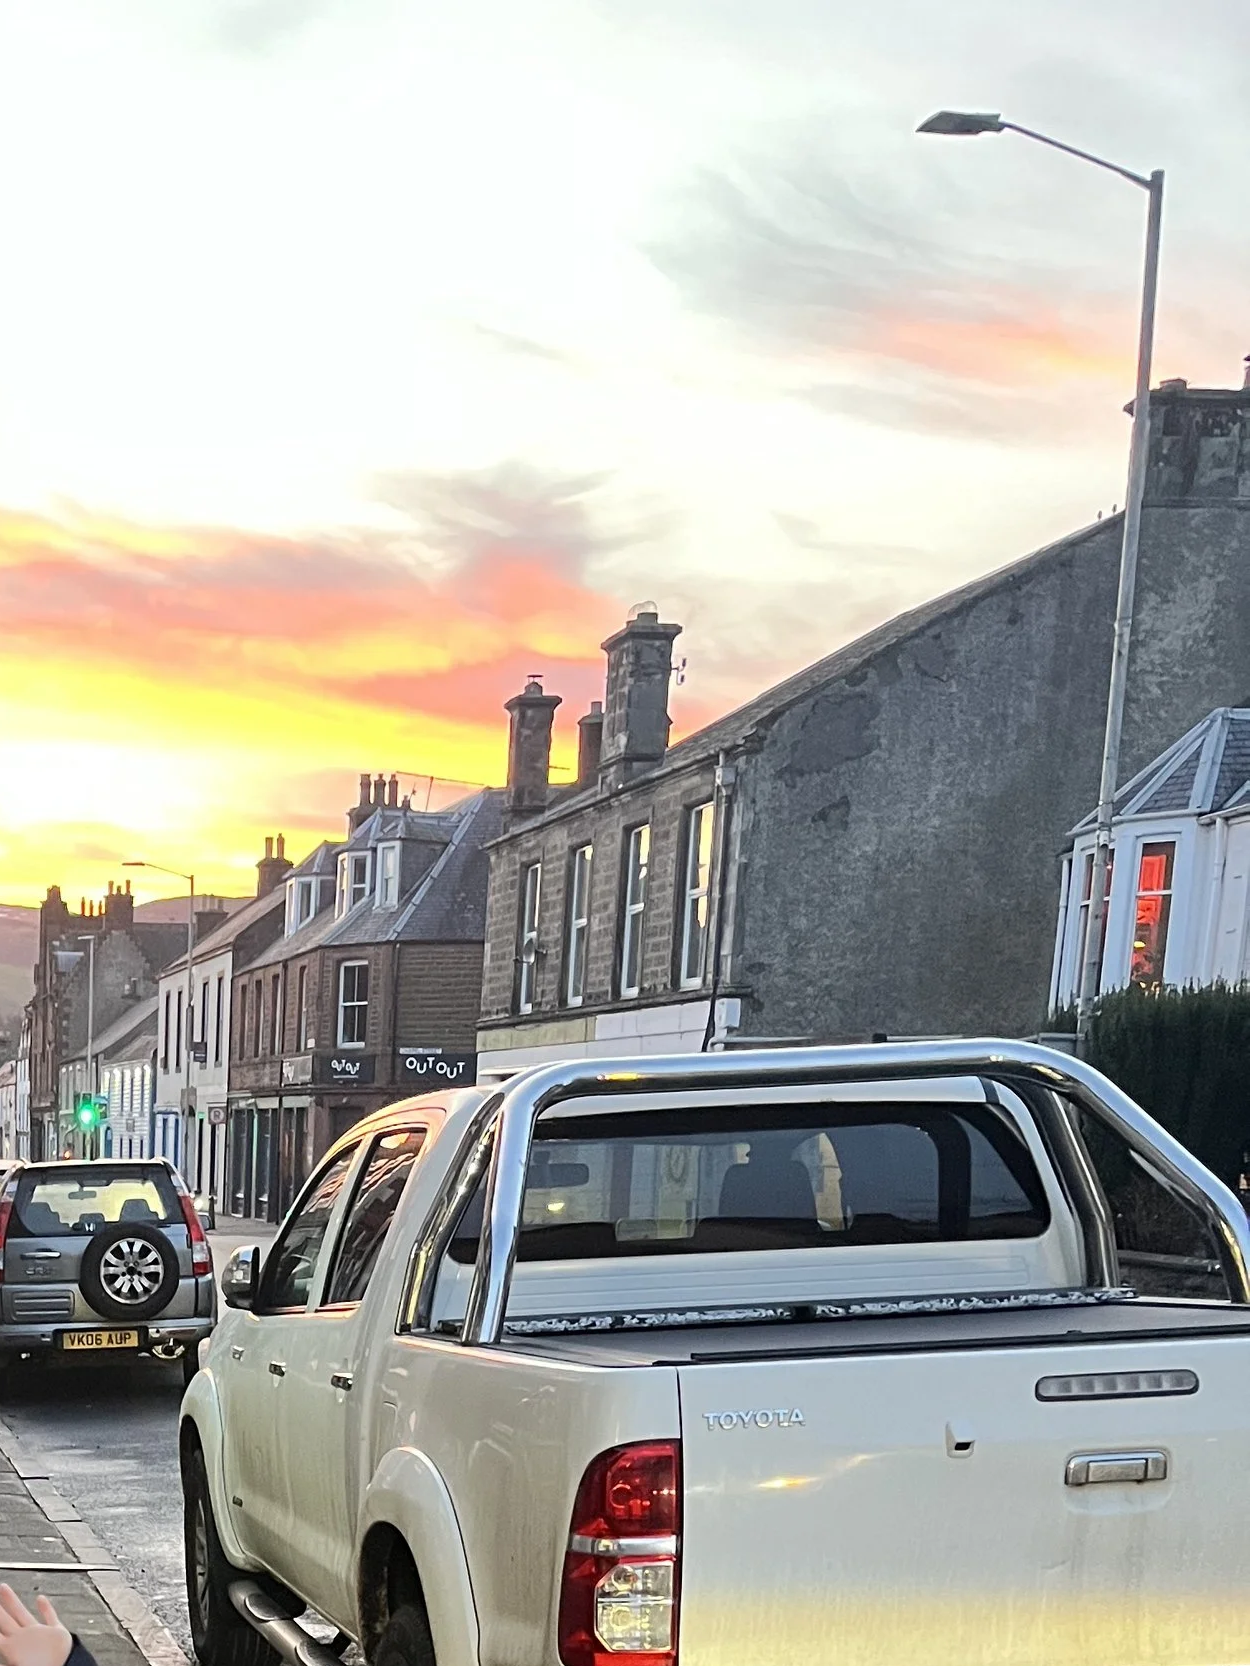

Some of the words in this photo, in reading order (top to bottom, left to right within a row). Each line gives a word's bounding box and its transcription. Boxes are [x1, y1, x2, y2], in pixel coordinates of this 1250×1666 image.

[331, 1059, 346, 1072] OUT
[345, 1062, 360, 1074] OUT
[405, 1056, 435, 1074] OUT
[435, 1062, 465, 1079] OUT
[69, 1333, 103, 1346] VK06
[107, 1331, 132, 1345] AUP
[702, 1408, 806, 1430] TOYOTA
